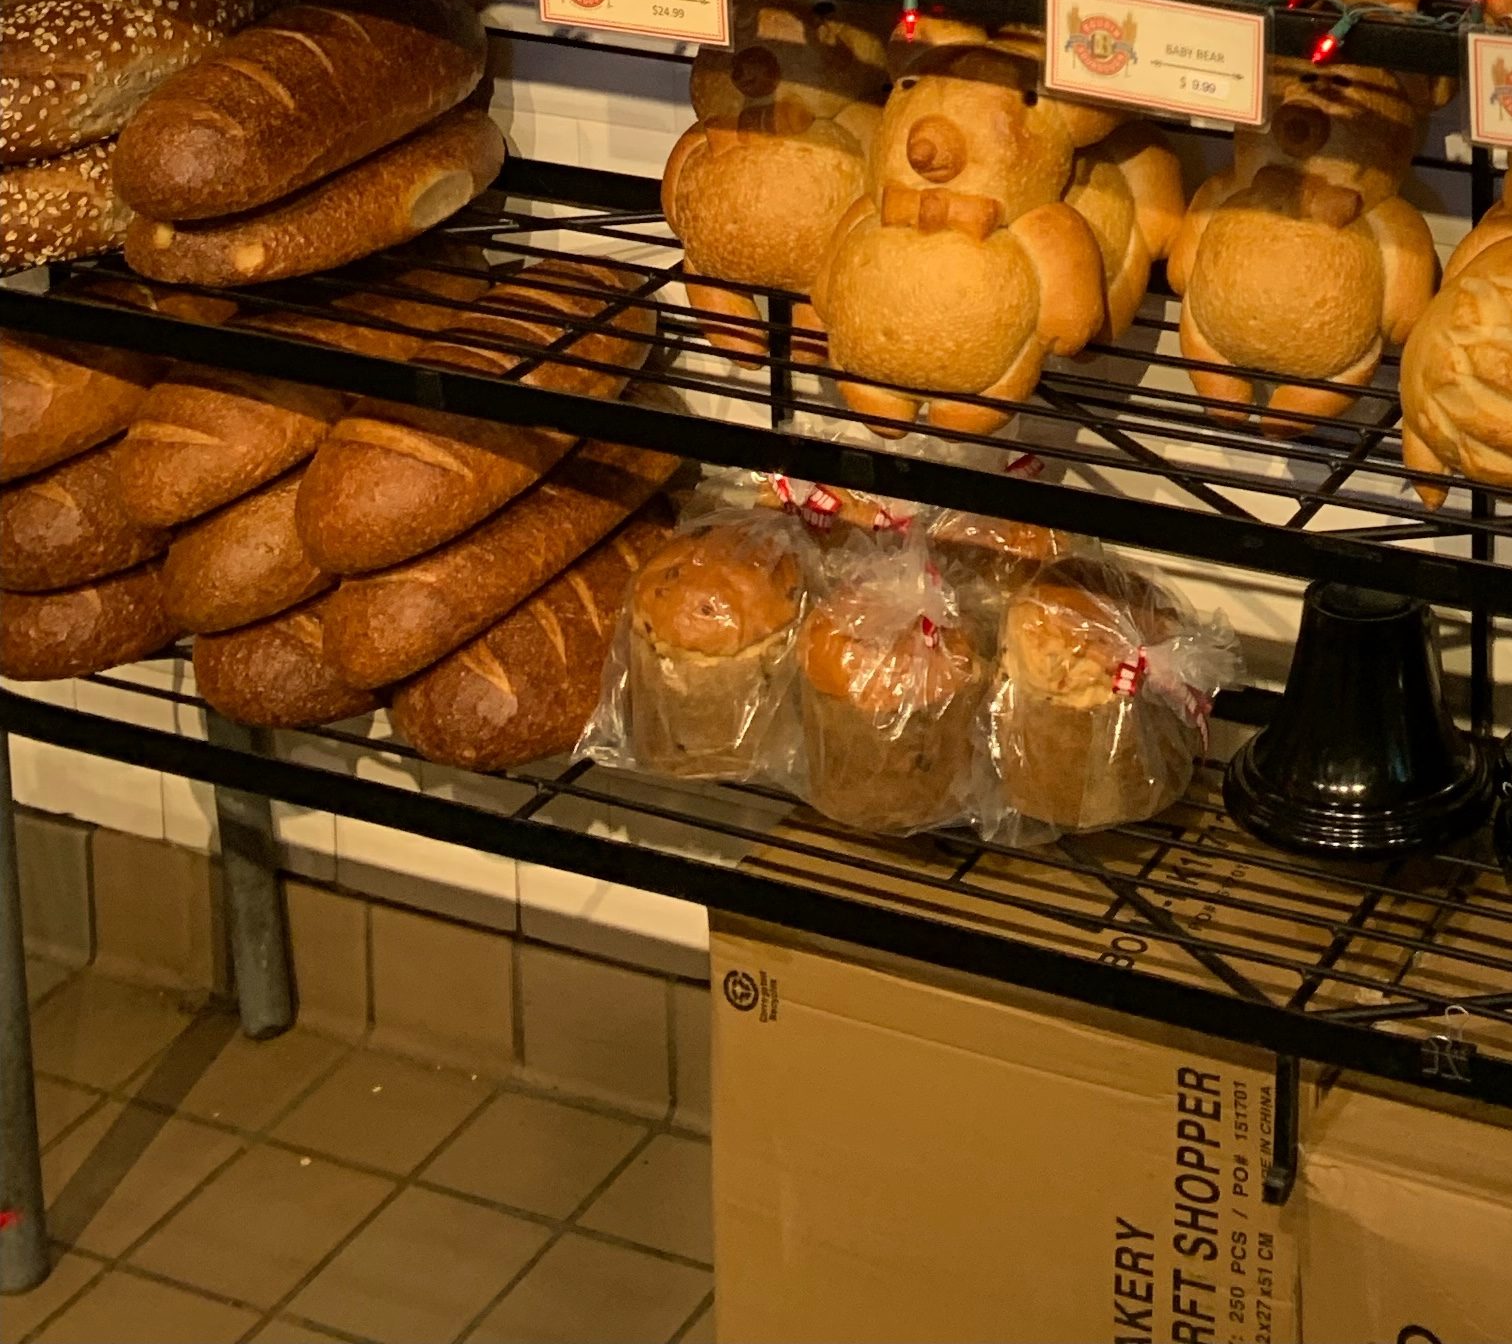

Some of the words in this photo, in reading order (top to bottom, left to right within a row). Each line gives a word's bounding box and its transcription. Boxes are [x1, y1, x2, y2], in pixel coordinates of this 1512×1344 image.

[652, 4, 685, 19] $24.99
[1165, 44, 1193, 58] BABY
[1196, 49, 1225, 63] BEAR
[1191, 80, 1217, 94] 9.99
[1233, 1080, 1249, 1141] 151701
[1259, 1085, 1272, 1136] CHINA
[1174, 1067, 1222, 1261] SHOPPER
[1260, 1138, 1272, 1156] IN
[1232, 1154, 1249, 1198] PO#
[1231, 1230, 1248, 1276] PCS
[1258, 1232, 1275, 1261] CM
[1113, 1216, 1155, 1344] KERY
[1229, 1286, 1246, 1324] 250
